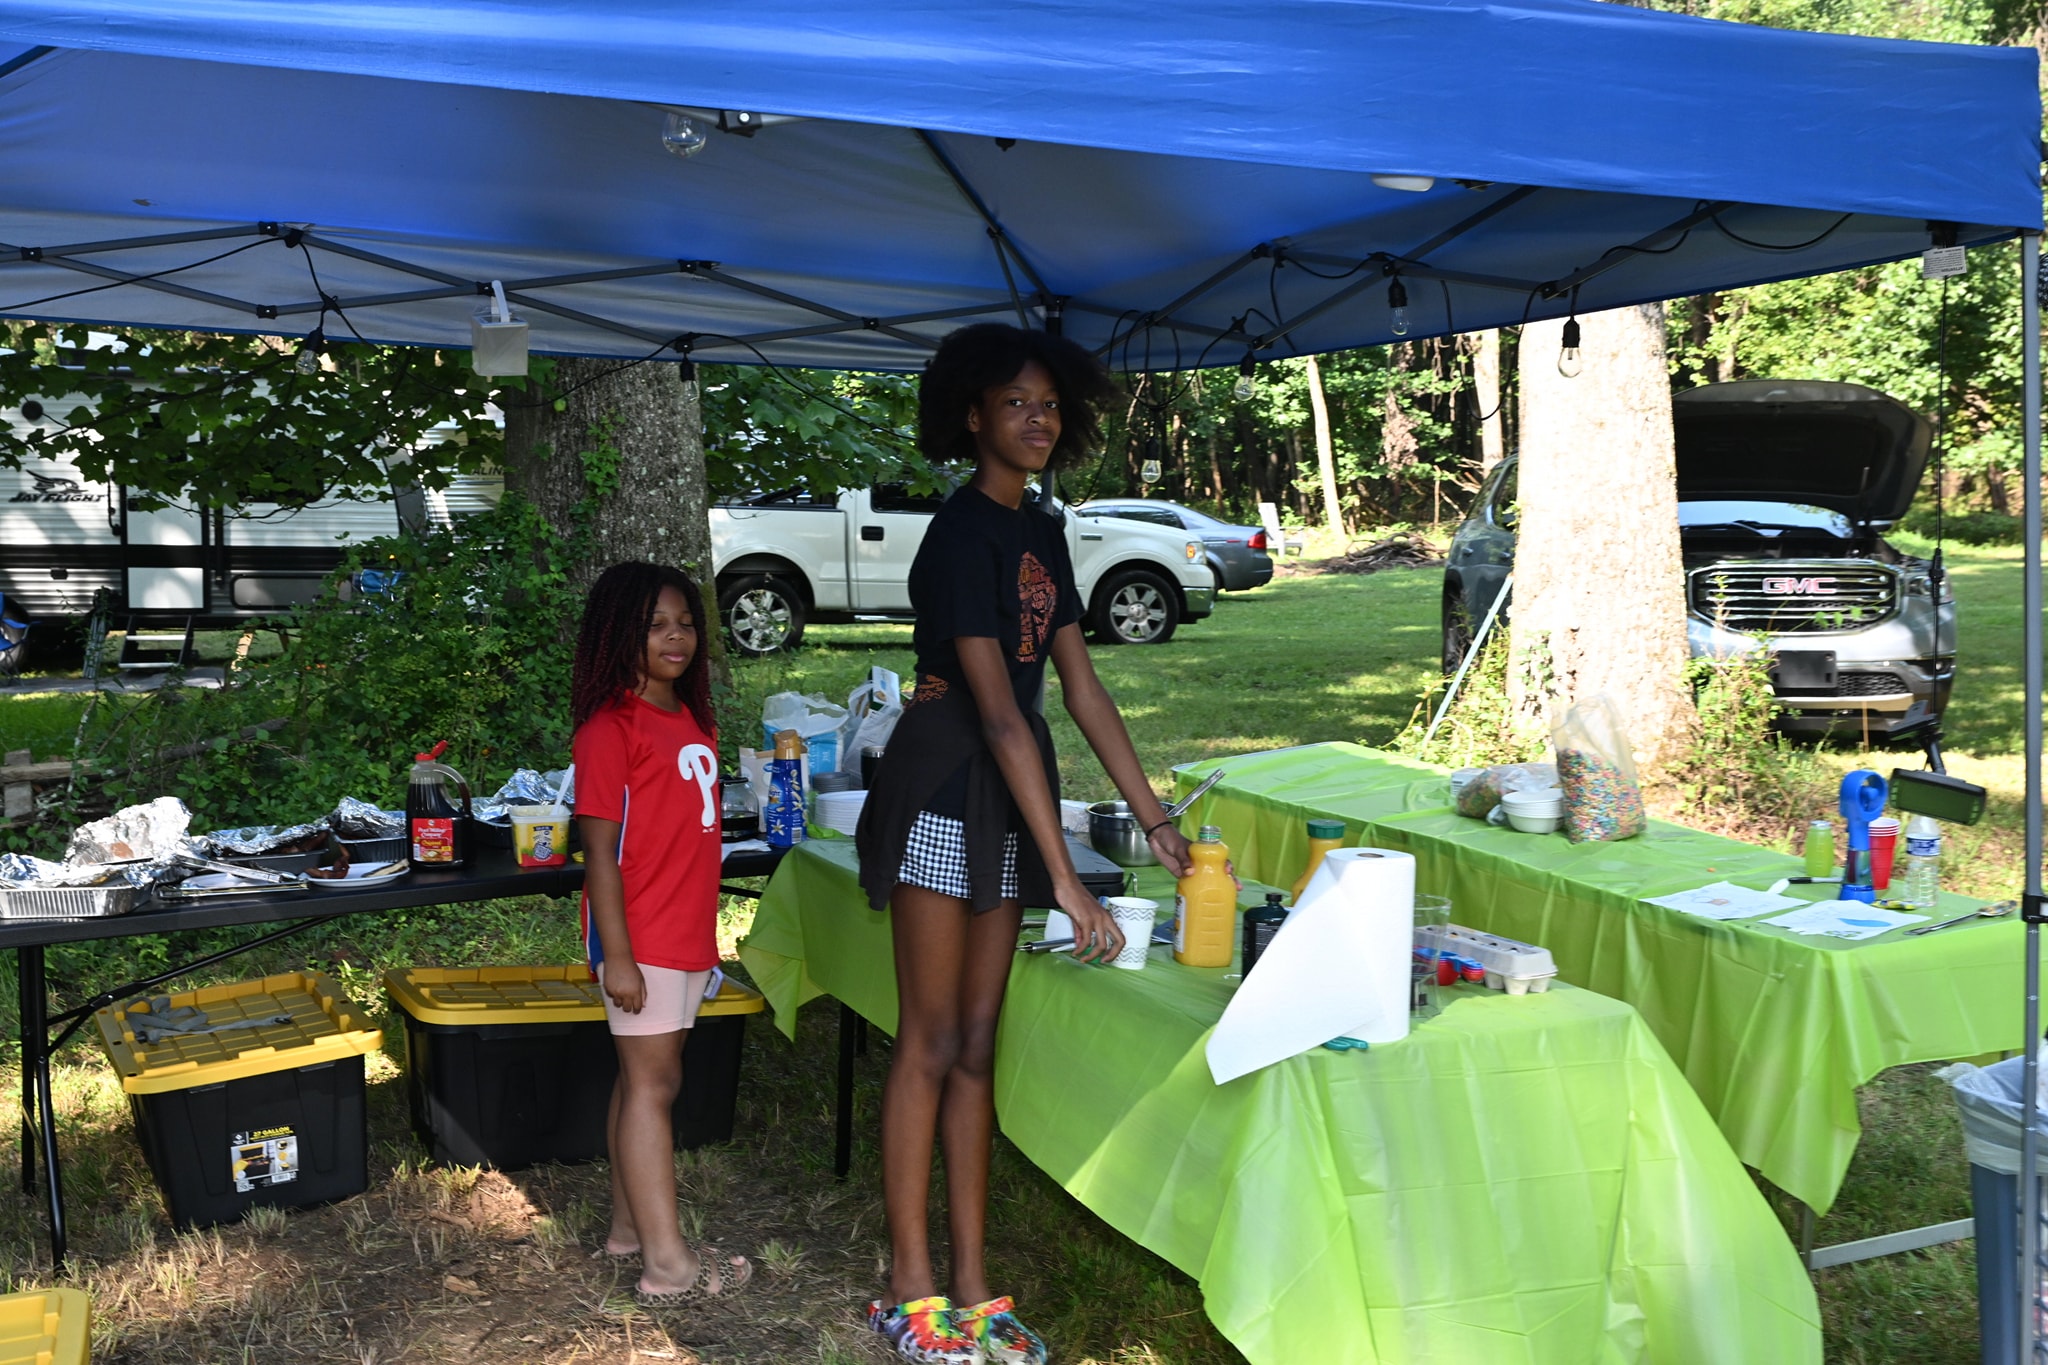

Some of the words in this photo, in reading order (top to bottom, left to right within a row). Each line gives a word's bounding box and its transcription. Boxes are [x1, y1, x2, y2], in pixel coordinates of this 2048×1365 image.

[8, 492, 41, 503] JAY
[41, 493, 105, 503] FLIGHT
[1762, 577, 1837, 594] GMC
[677, 744, 718, 828] P
[421, 839, 442, 847] Original
[262, 1126, 290, 1136] GALLON
